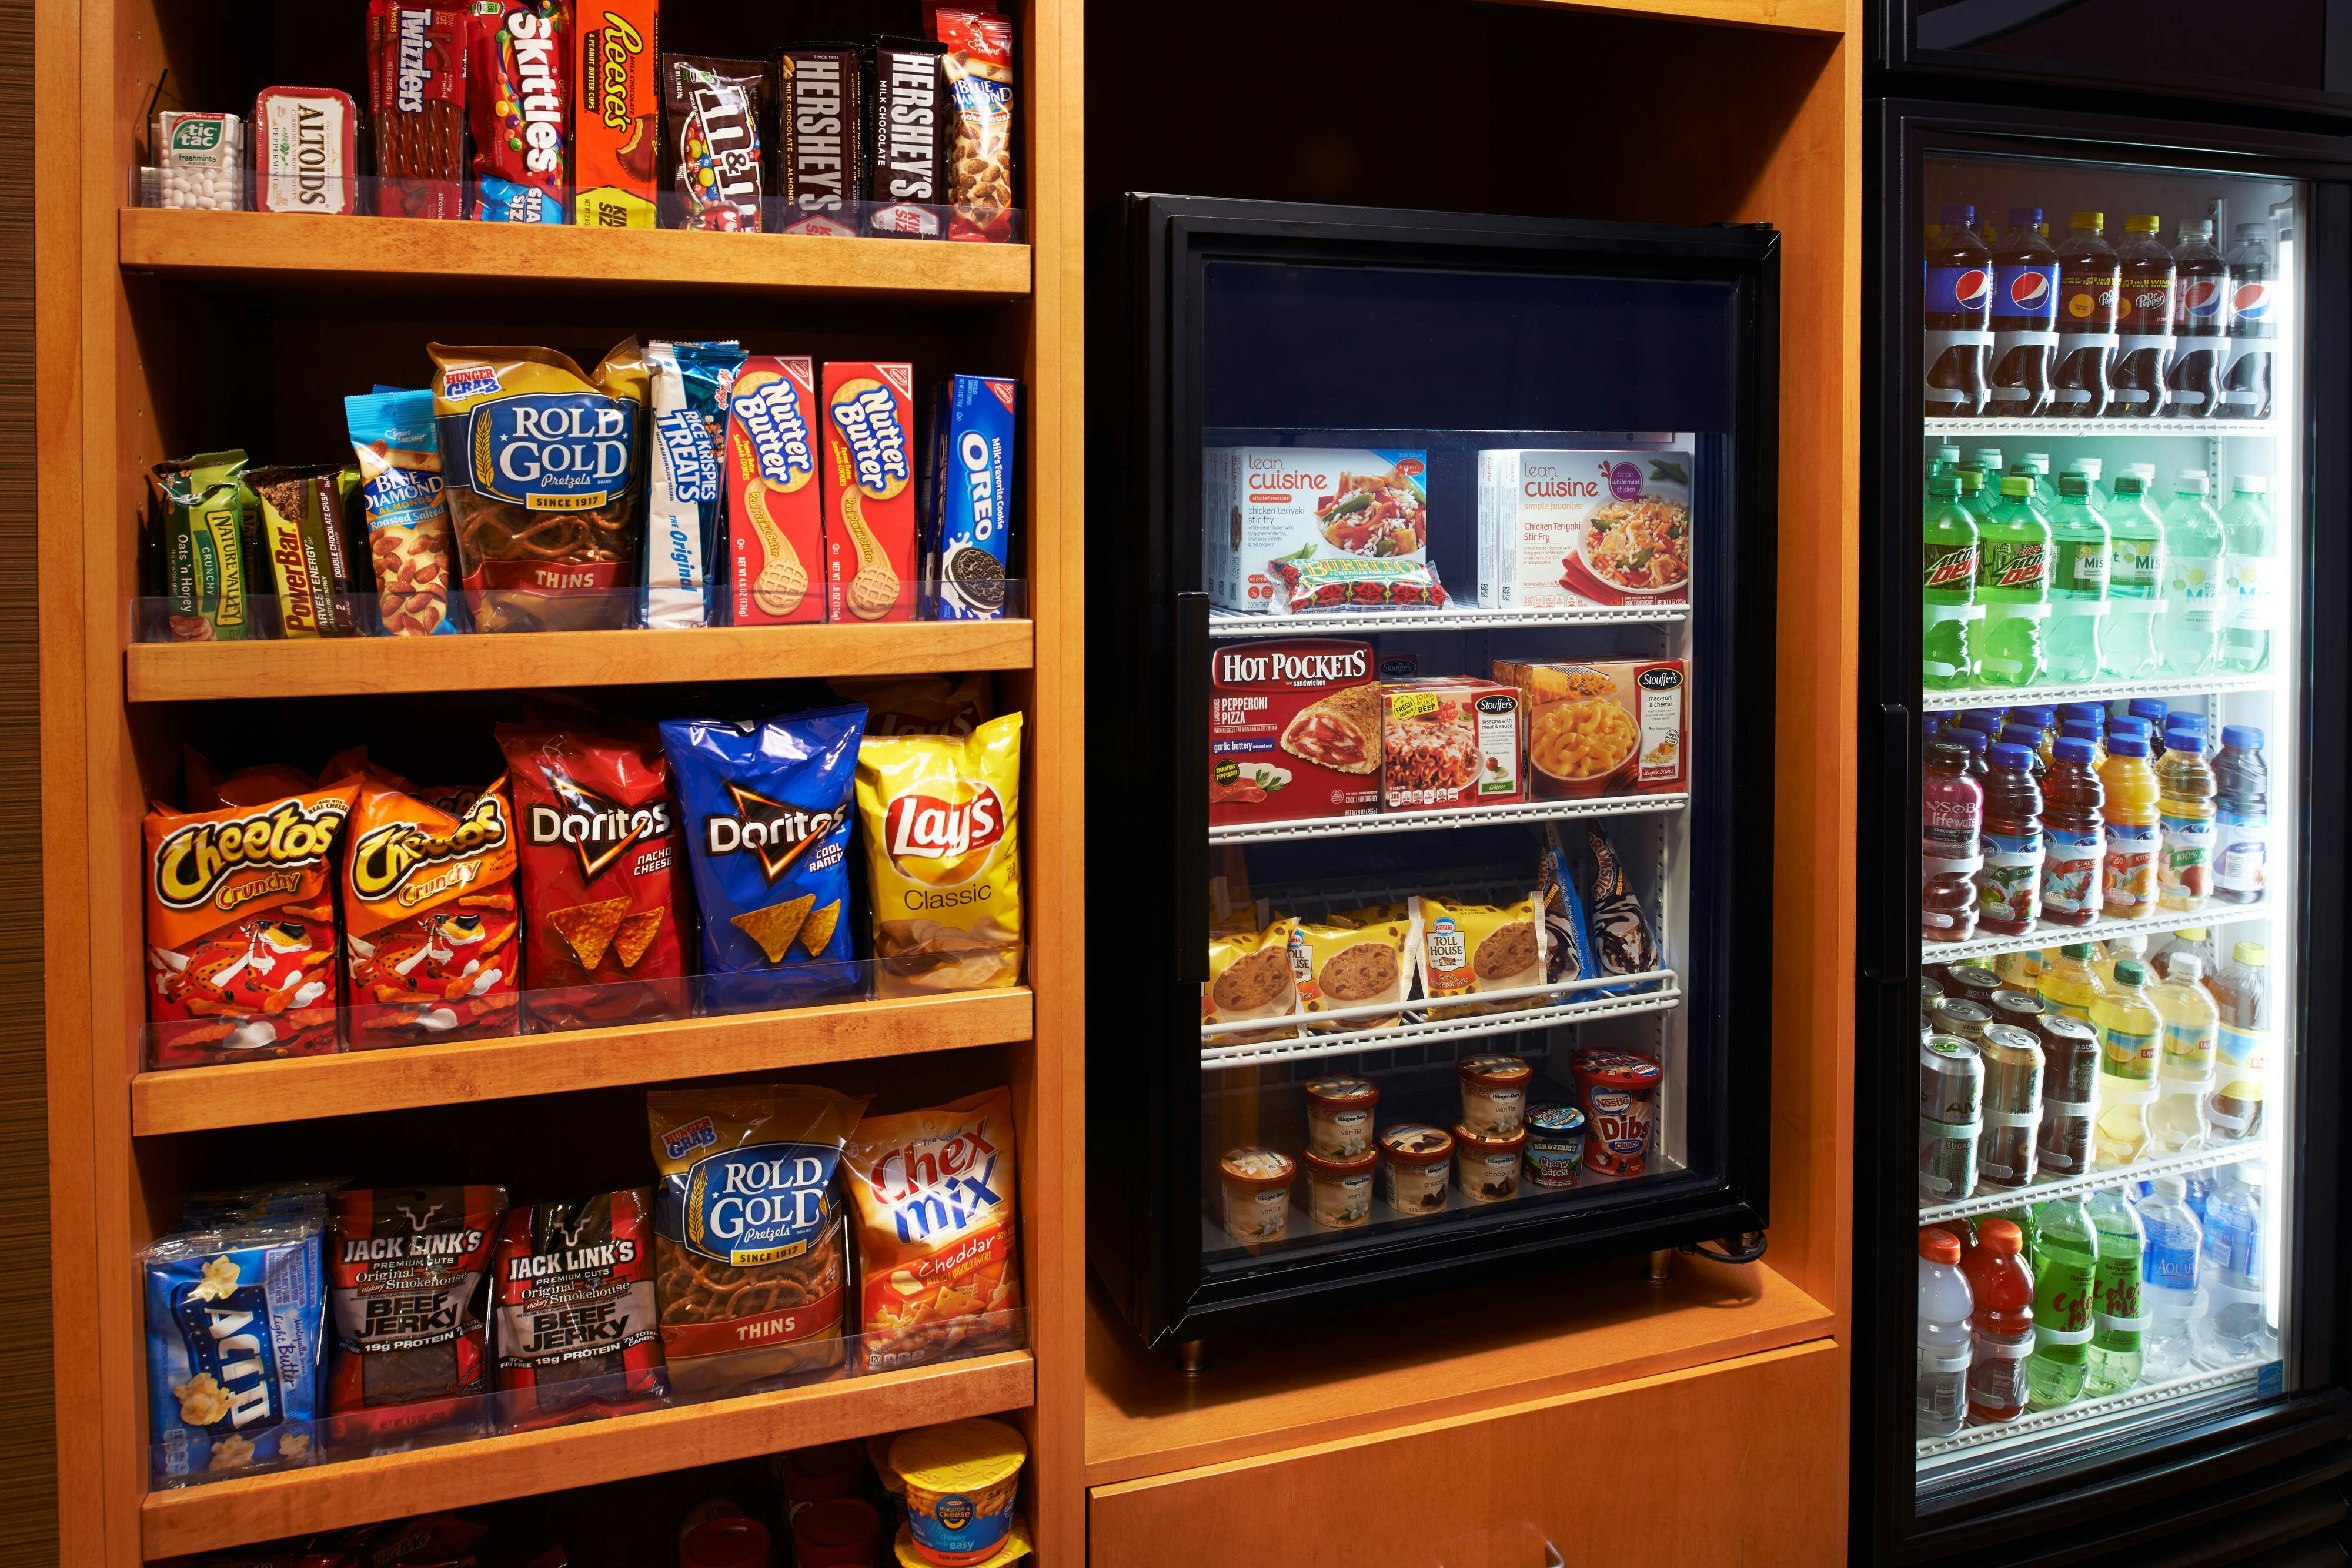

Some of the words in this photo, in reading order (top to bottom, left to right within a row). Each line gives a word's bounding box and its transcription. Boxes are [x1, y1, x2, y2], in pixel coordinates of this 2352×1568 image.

[603, 11, 643, 133] Reese's
[508, 12, 560, 172] Skittles
[188, 123, 215, 136] tic
[796, 61, 843, 211] HERSHEY'S
[890, 54, 934, 198] HERSHEY'S
[181, 135, 212, 146] tac
[179, 154, 216, 163] freshmints
[298, 103, 326, 205] ALTOIDS
[2136, 295, 2165, 309] Pepper
[446, 368, 494, 385] HUNGER
[446, 379, 499, 399] GRAB
[512, 407, 624, 442] ROLD
[761, 377, 813, 473] Nutter
[735, 396, 787, 482] Butter
[992, 437, 1001, 464] Milk's
[500, 441, 628, 481] GOLD
[658, 413, 700, 502] TREATS
[660, 446, 671, 480] MARSHMALLOW
[683, 411, 708, 442] RICE
[696, 440, 717, 500] KRISPIES
[733, 434, 744, 458] Sandwich
[740, 458, 750, 480] COOKIES
[542, 471, 590, 487] Pretzels
[1249, 470, 1328, 490] cuisine
[1525, 463, 1558, 477] lean
[363, 477, 443, 510] DIAMOND
[375, 472, 421, 493] BLUE
[962, 433, 992, 541] OREO
[1525, 477, 1599, 497] cuisine
[320, 493, 330, 511] CRISP
[378, 495, 432, 515] ALMONDS
[536, 498, 571, 507] SINCE
[575, 496, 598, 506] 1917
[1248, 506, 1275, 514] chicken
[1277, 506, 1305, 516] teriyaki
[370, 511, 411, 530] Roasted
[413, 504, 444, 521] Salted
[1263, 516, 1274, 525] fry
[1554, 522, 1581, 532] Teriyaki
[212, 515, 237, 570] NATURE
[325, 511, 338, 550] CHOCOLATE
[1538, 533, 1550, 543] Fry
[178, 535, 188, 560] Oats
[1932, 549, 1975, 569] Mtn
[2020, 545, 2041, 556] diet
[202, 547, 214, 596] CRUNCHY
[305, 542, 320, 584] ENERGY
[333, 551, 342, 578] DOUBLE
[669, 530, 697, 593] Original
[1305, 560, 1415, 577] BURRITO
[275, 526, 315, 631] PowerBar
[535, 570, 594, 588] THINS
[181, 579, 192, 612] Honey
[221, 571, 242, 619] VALLEY
[1643, 672, 1677, 686] Stouffer's
[1222, 697, 1267, 711] PEPPERONI
[1396, 701, 1413, 714] FRESH
[1418, 704, 1435, 713] BEEF
[1481, 699, 1512, 711] Stouffer's
[1222, 711, 1245, 724] PIZZA
[1214, 743, 1231, 753] garlic
[1232, 741, 1252, 751] buttery
[1216, 764, 1235, 774] SIGNATURE
[1216, 770, 1238, 780] PEPPERONI
[533, 803, 670, 844] Doritos
[710, 804, 846, 852] Doritos
[893, 795, 994, 858] Lay's
[163, 804, 339, 899] Cheetos
[637, 847, 671, 865] NACHO
[809, 852, 844, 872] RANCH
[816, 843, 842, 859] COOL
[2177, 852, 2197, 861] 100%
[634, 857, 673, 876] CHEESE
[1588, 832, 1613, 901] DRUMSTICK
[217, 872, 300, 909] Crunchy
[904, 884, 991, 910] Classic
[1430, 947, 1462, 956] HOUSE
[1434, 937, 1457, 947] TOLL
[1599, 1116, 1650, 1141] Dibs
[1615, 1141, 1639, 1149] CRUNCH
[870, 1117, 995, 1205] Chex
[1539, 1158, 1569, 1168] Cherry
[1541, 1167, 1568, 1176] Garcia
[724, 1157, 823, 1196] ROLD
[896, 1151, 1003, 1244] mix
[710, 1189, 825, 1239] GOLD
[344, 1237, 403, 1262] JACK
[410, 1231, 482, 1256] LINK'S
[744, 1226, 790, 1243] Pretzels
[509, 1253, 563, 1280] JACK
[566, 1240, 634, 1268] LINK'S
[740, 1251, 771, 1263] SINCE
[775, 1246, 799, 1260] 1917
[918, 1235, 995, 1278] Cheddar
[536, 1274, 582, 1285] PREMIUM
[585, 1269, 609, 1278] CUTS
[521, 1282, 574, 1299] Original
[527, 1299, 548, 1310] Hickory
[550, 1283, 631, 1304] Smokehouse
[534, 1302, 616, 1333] BEEF
[737, 1316, 796, 1340] THINS
[204, 1308, 262, 1359] ACT
[523, 1314, 630, 1352] JERKY
[272, 1315, 286, 1343] Light
[279, 1345, 295, 1388] Butter
[563, 1343, 620, 1361] PROTEIN
[950, 1540, 974, 1551] easy
